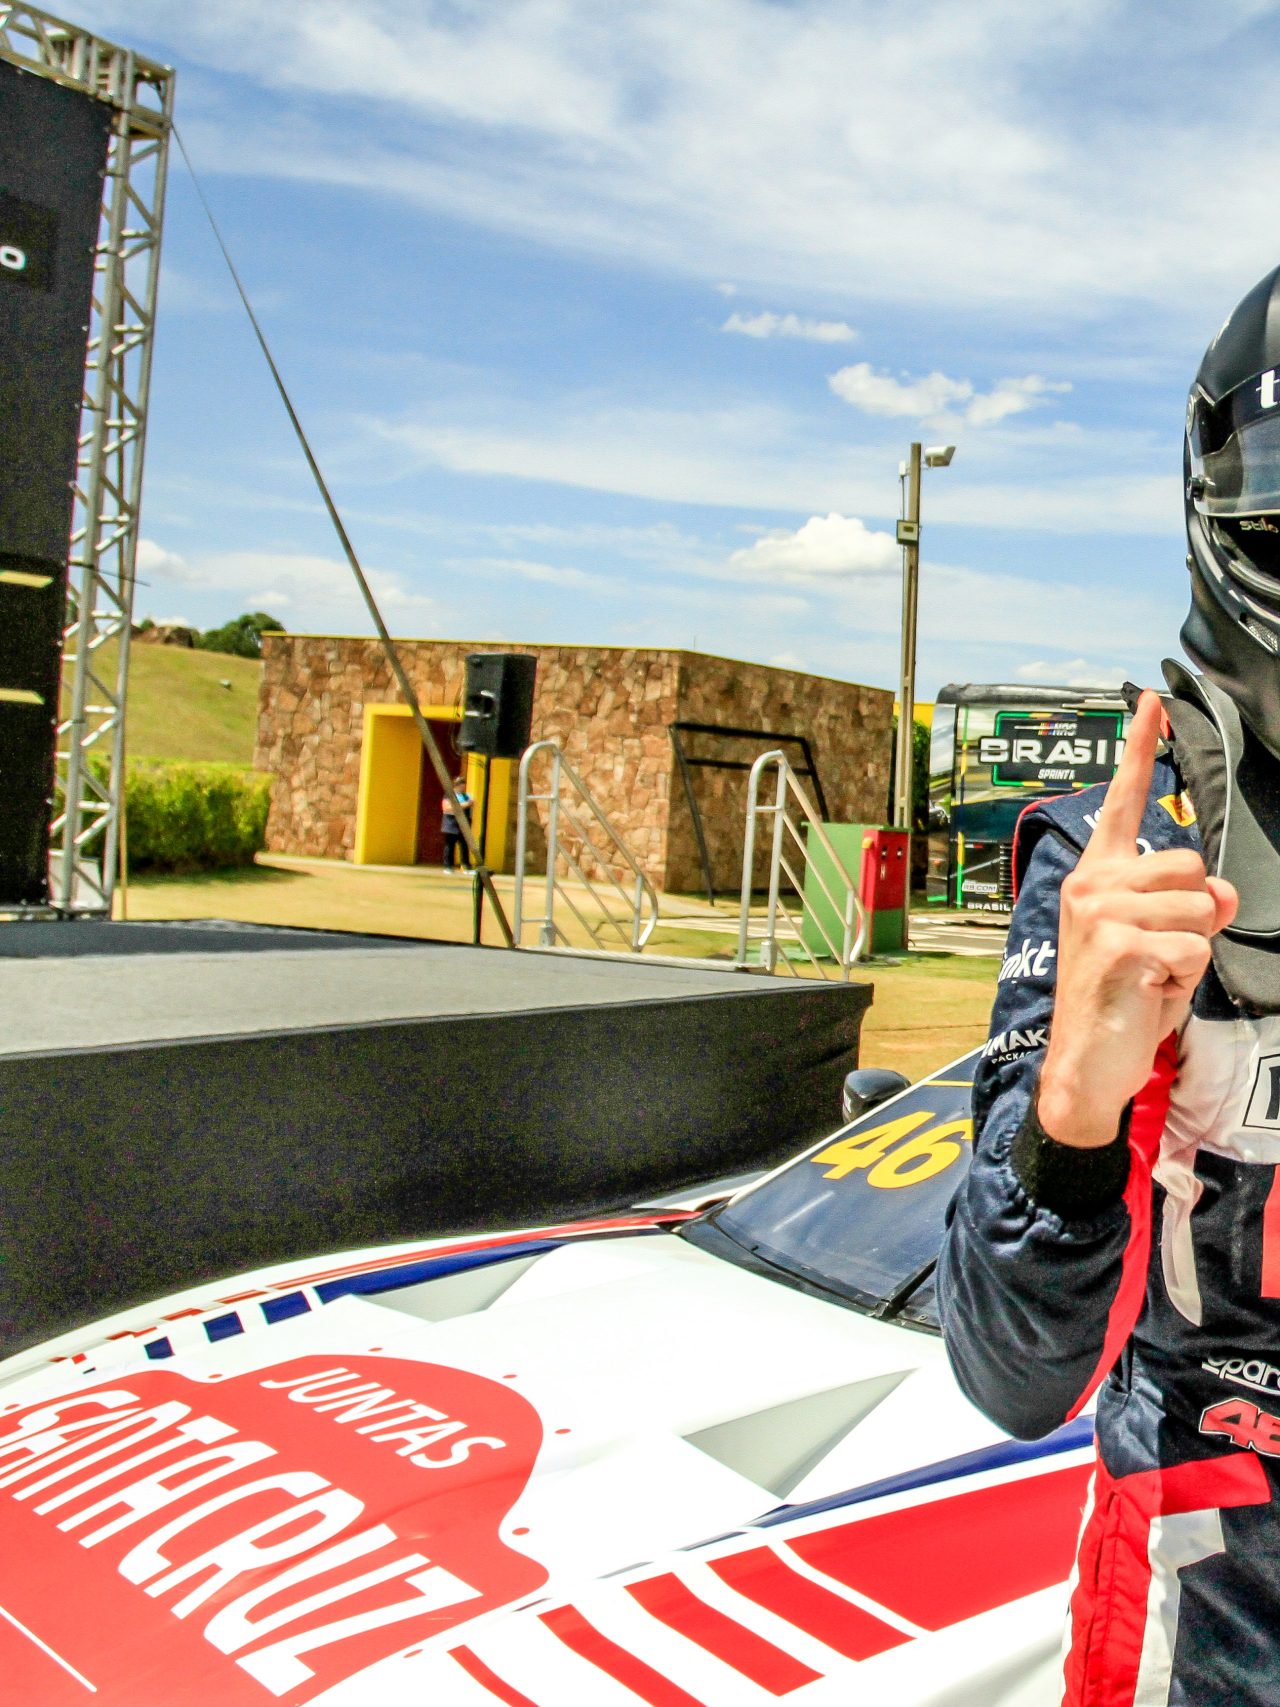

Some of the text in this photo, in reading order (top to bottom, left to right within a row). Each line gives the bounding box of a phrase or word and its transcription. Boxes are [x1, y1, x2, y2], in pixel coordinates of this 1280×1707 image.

[1037, 768, 1069, 780] SPRINT
[967, 902, 1011, 912] BRASIL
[810, 1111, 974, 1189] 46
[259, 1367, 507, 1469] JUNTAS
